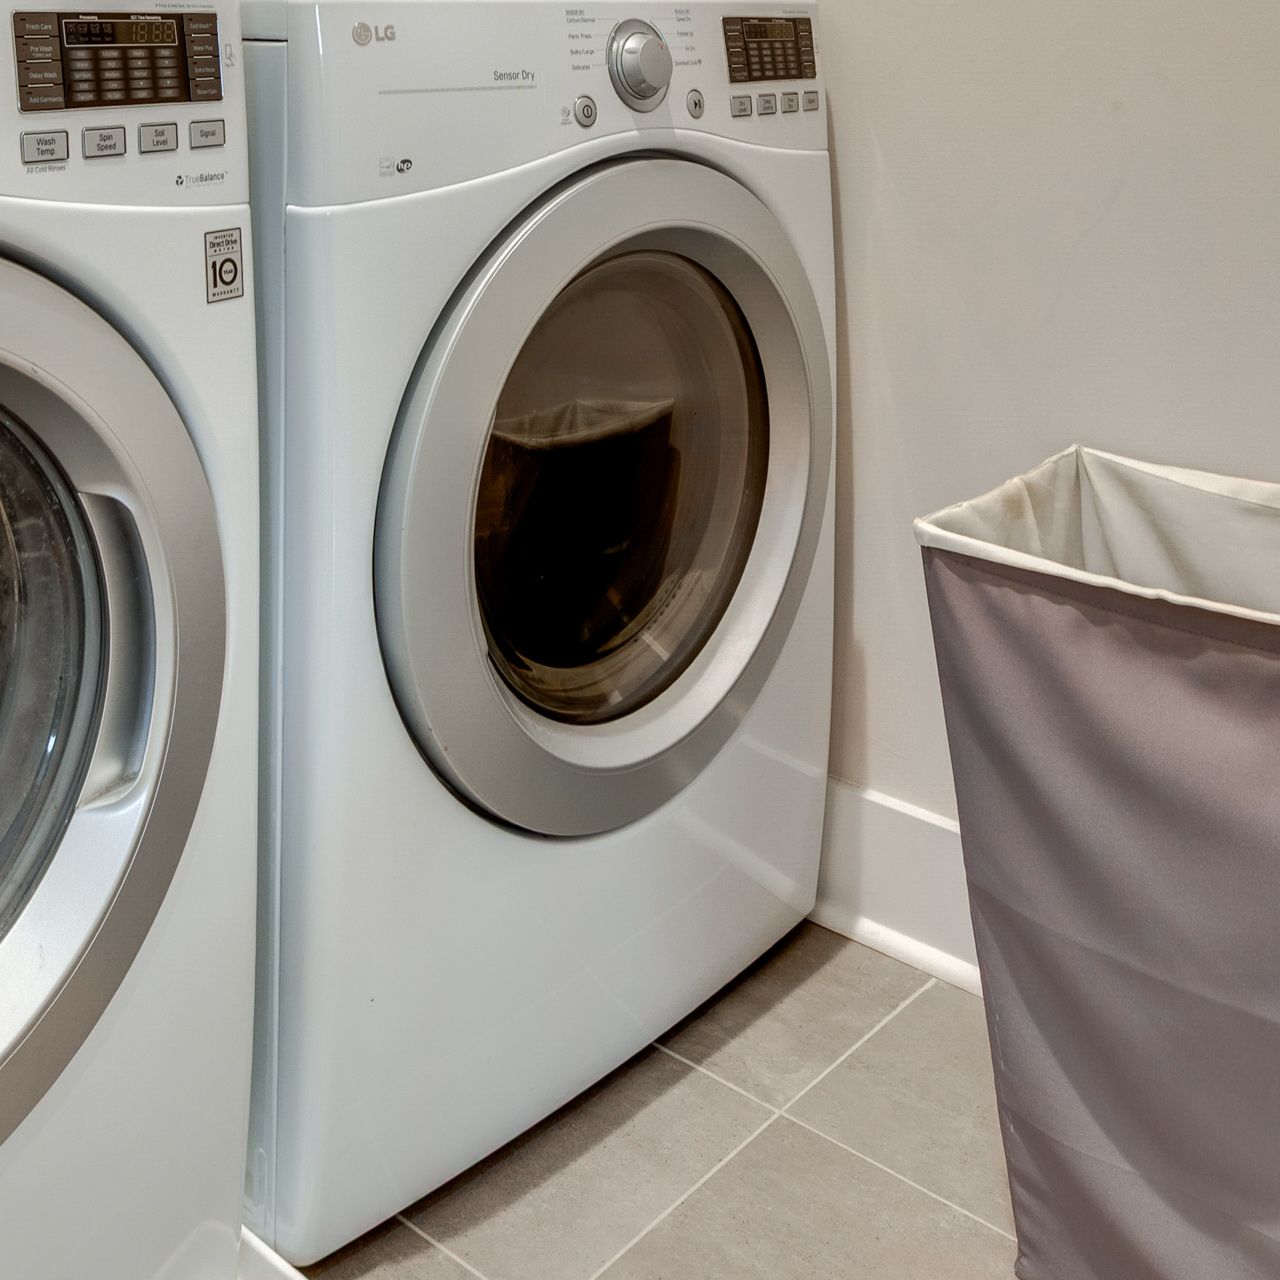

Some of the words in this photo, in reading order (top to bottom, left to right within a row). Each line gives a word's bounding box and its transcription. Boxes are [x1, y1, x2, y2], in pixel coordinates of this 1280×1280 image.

[374, 25, 396, 41] LG
[493, 70, 520, 81] Sensor
[521, 70, 535, 82] Dry
[99, 133, 113, 142] Spin
[154, 128, 166, 138] Soil
[199, 129, 216, 139] Signal
[36, 137, 56, 146] Wash
[152, 138, 168, 147] Level
[36, 147, 55, 157] Temp
[96, 142, 116, 152] Speed
[209, 241, 225, 249] Direct
[211, 257, 238, 288] 10
[212, 287, 239, 297] WARRANTY
